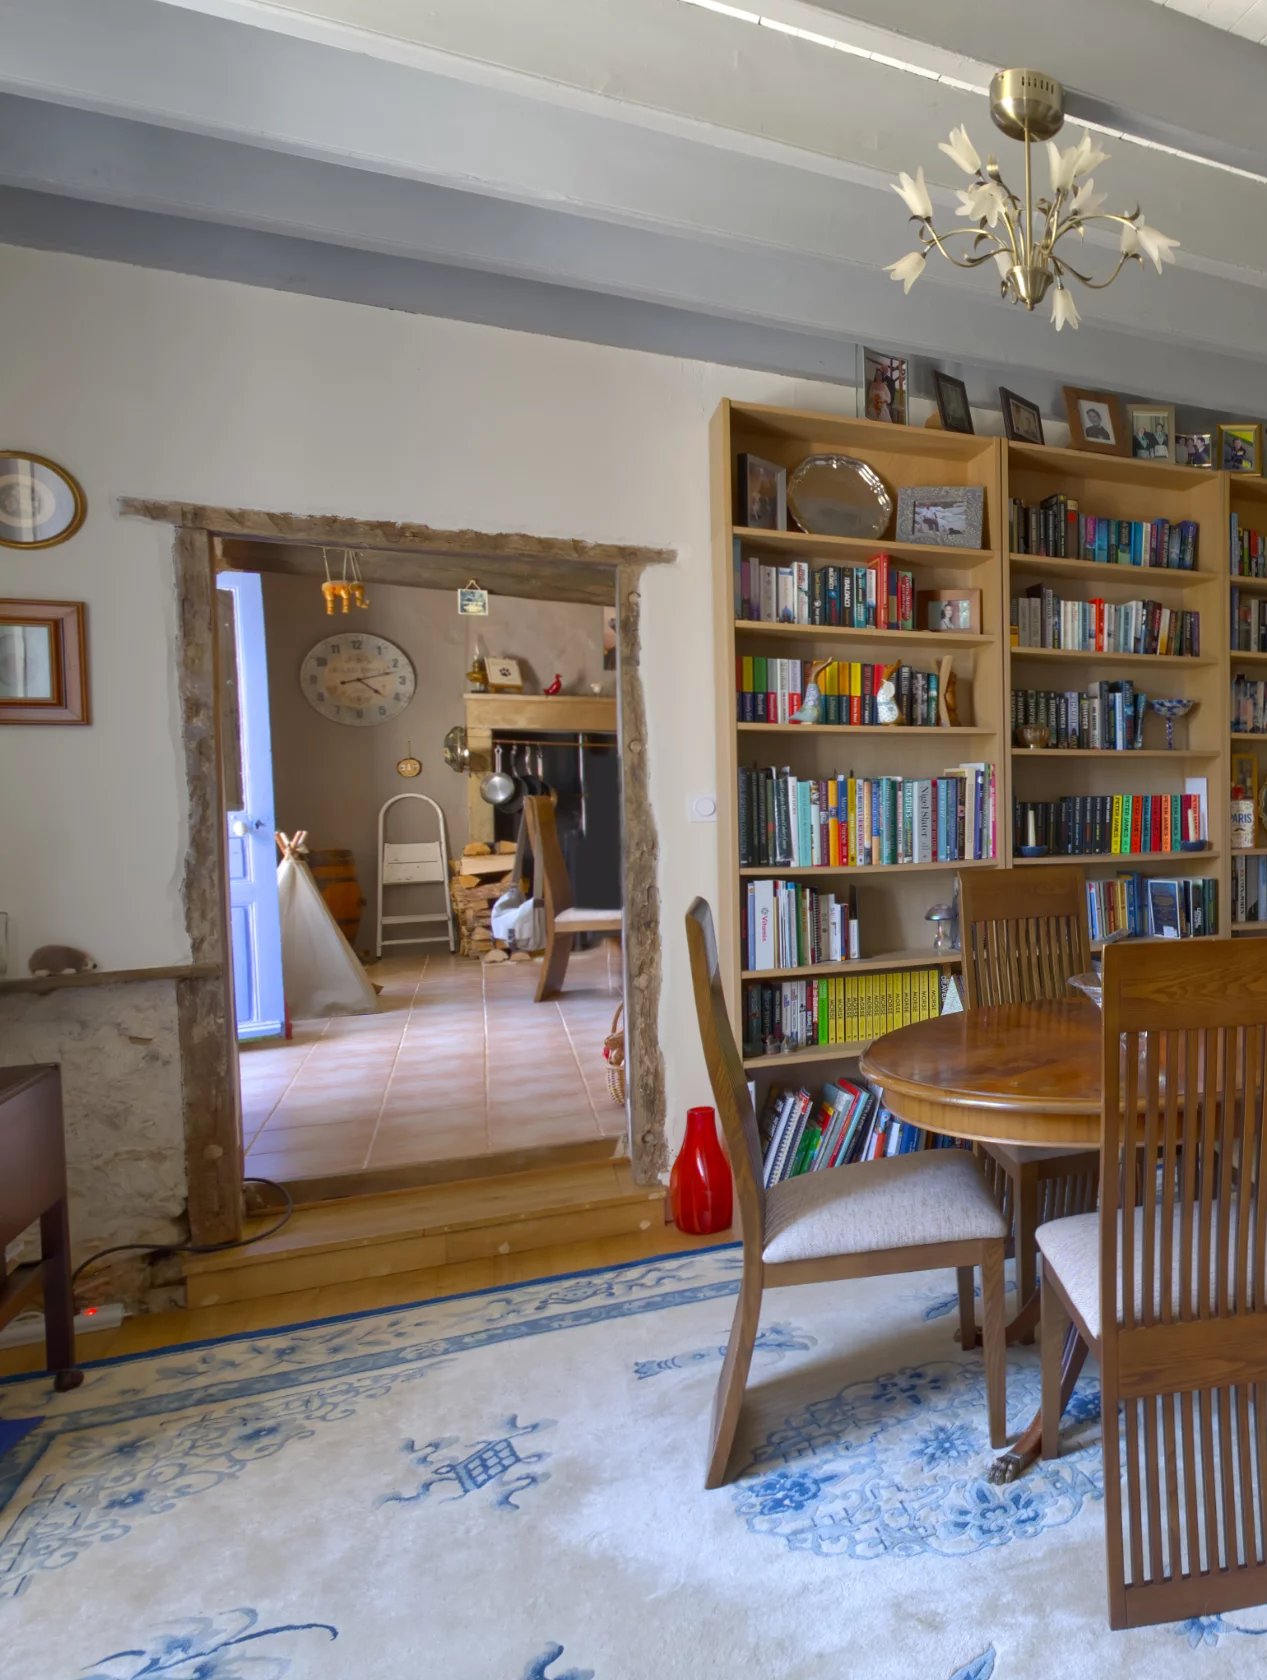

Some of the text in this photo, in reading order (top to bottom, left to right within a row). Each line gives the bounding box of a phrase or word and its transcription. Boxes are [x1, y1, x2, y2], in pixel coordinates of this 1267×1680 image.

[331, 645, 340, 654] 11
[352, 640, 362, 650] 12
[392, 658, 399, 668] 2
[399, 676, 406, 685] 3
[379, 706, 386, 715] 5
[920, 786, 928, 809] Nigel
[1232, 814, 1252, 823] ARIS
